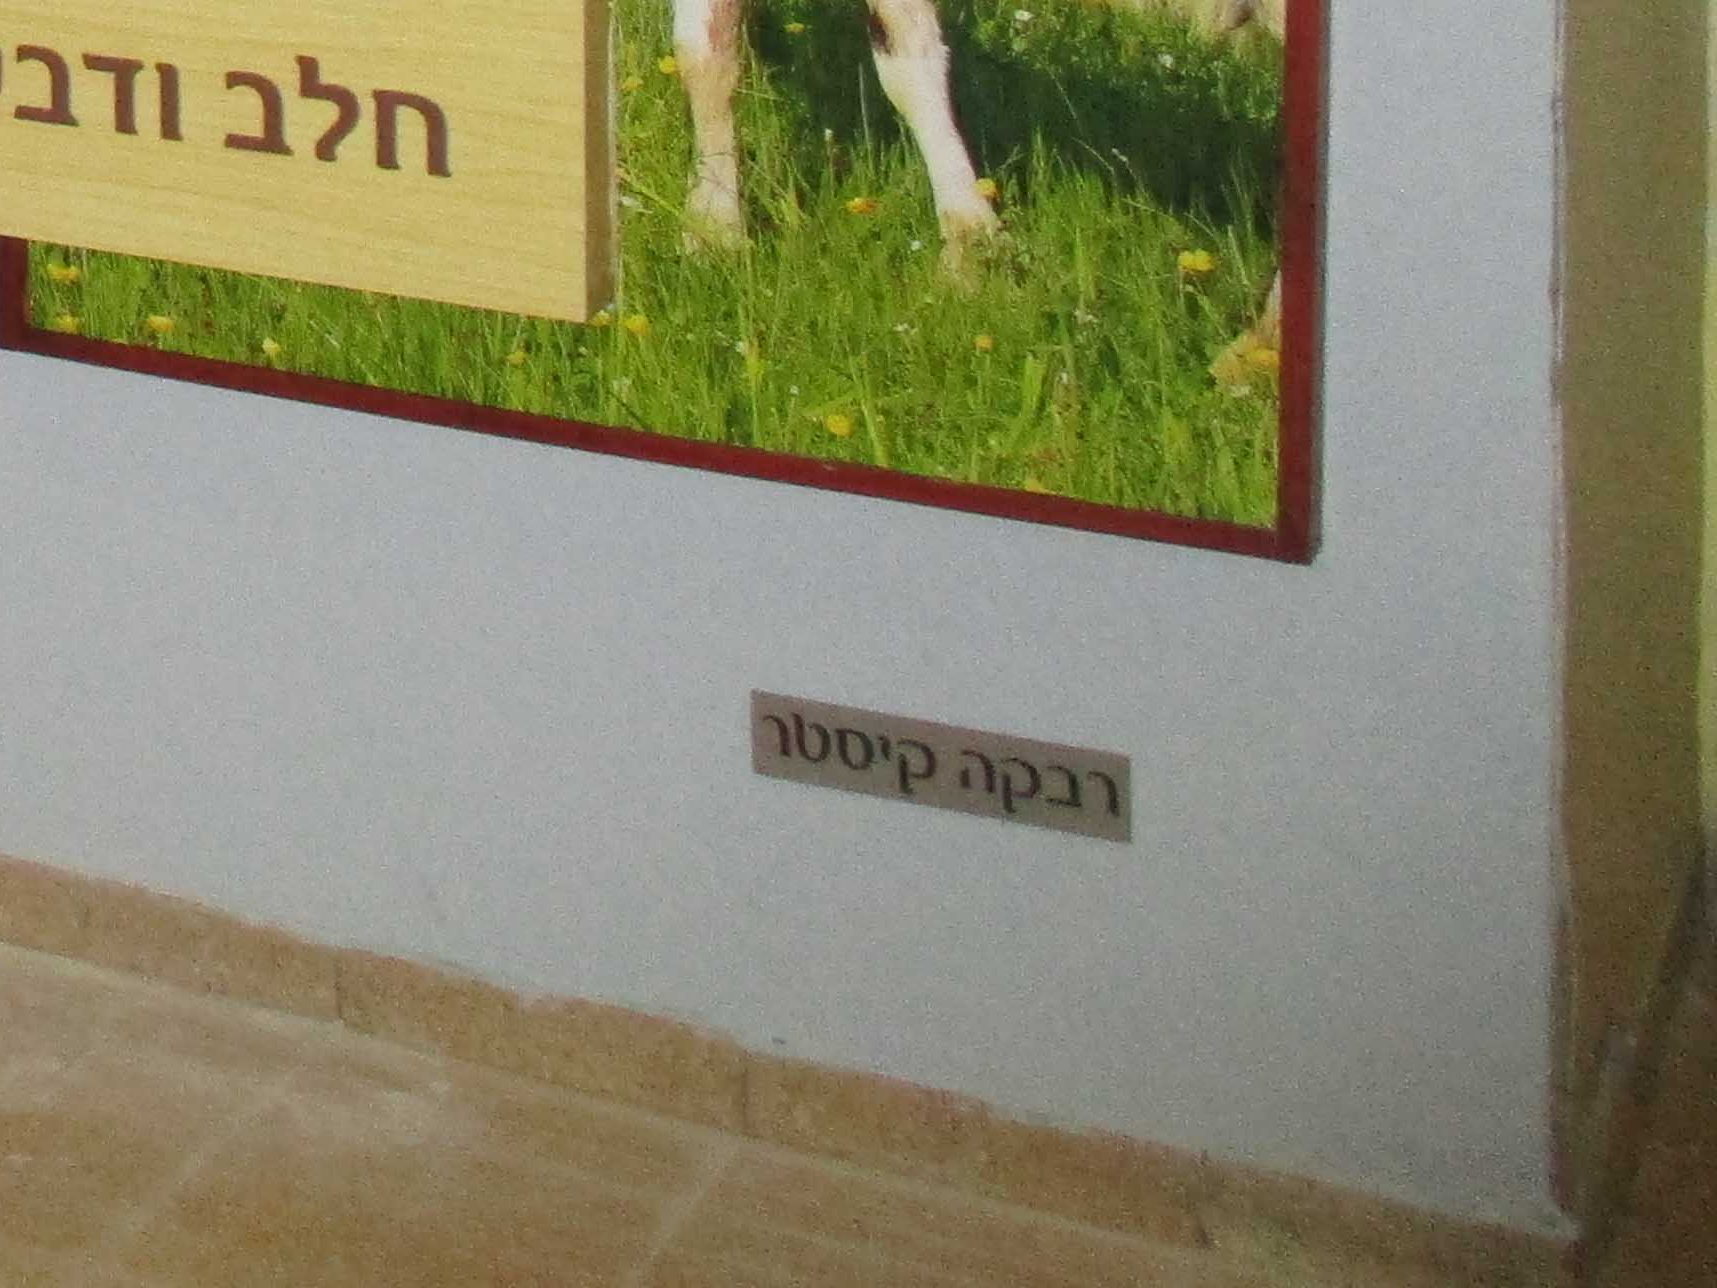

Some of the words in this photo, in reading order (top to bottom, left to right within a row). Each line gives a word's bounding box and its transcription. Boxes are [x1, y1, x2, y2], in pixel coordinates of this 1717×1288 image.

[224, 54, 452, 180] חלב
[763, 712, 937, 796] קיסטר
[960, 749, 1121, 817] רבקה
